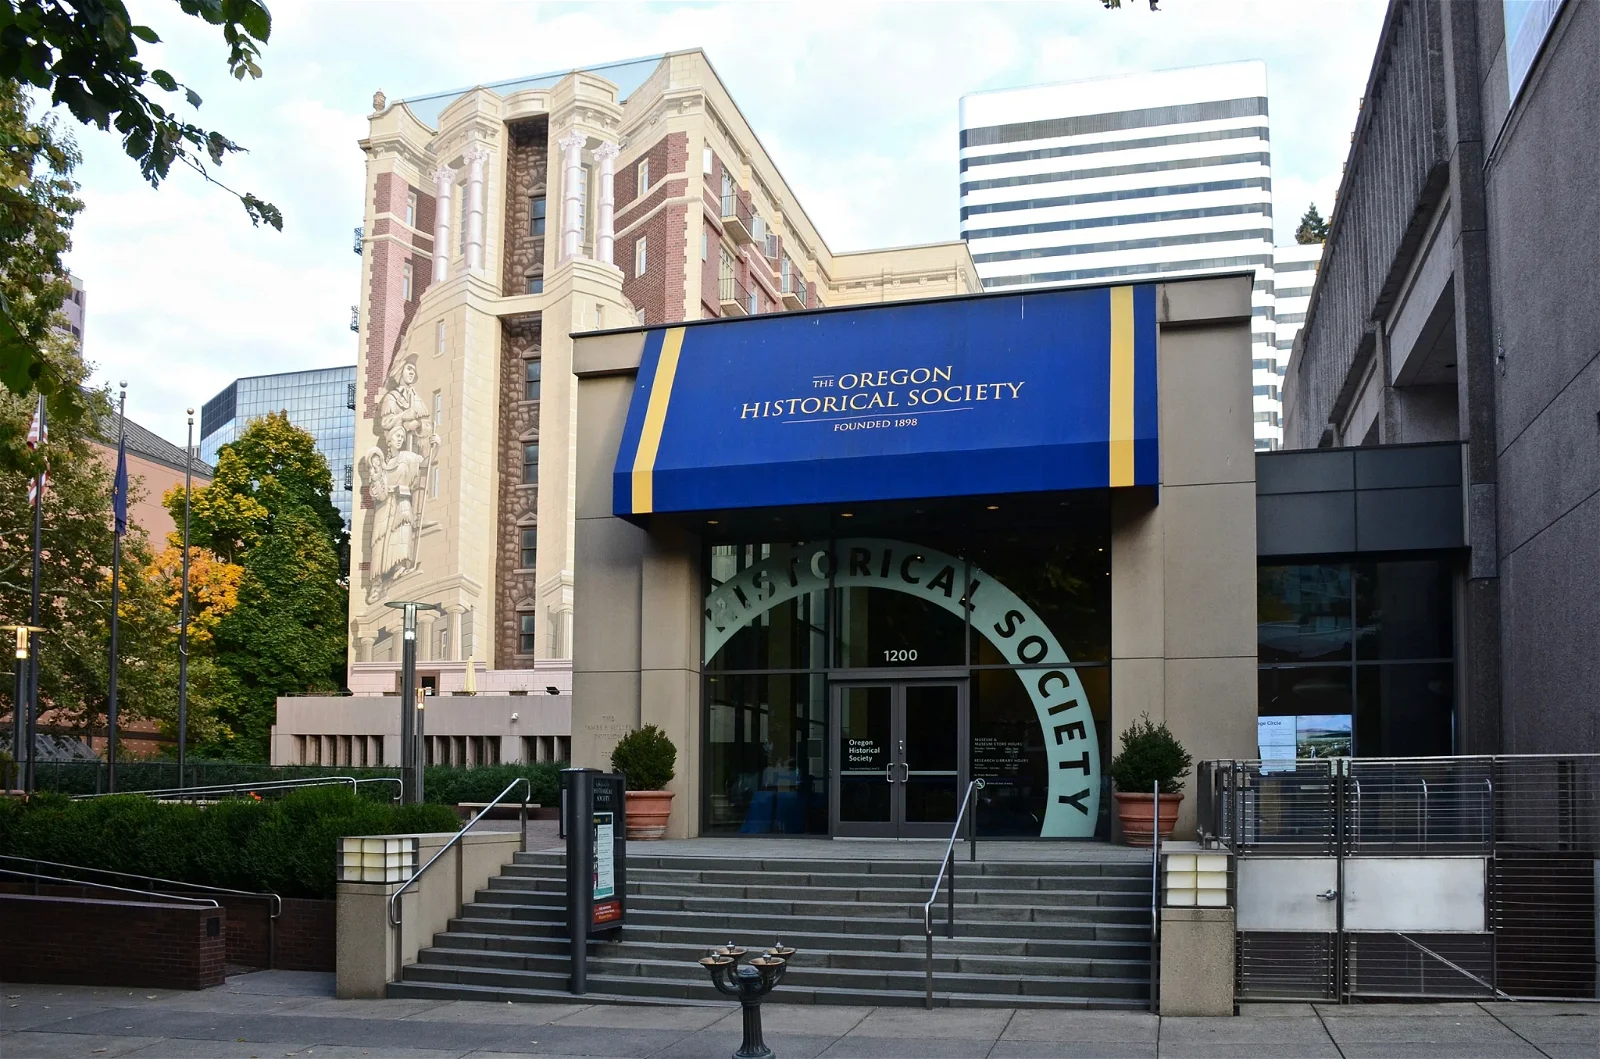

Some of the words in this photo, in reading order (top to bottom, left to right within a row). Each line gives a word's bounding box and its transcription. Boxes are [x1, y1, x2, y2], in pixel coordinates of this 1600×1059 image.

[812, 378, 834, 388] THE
[838, 365, 953, 390] OREGON
[740, 391, 900, 419] HISTORICAL
[907, 381, 1025, 406] SOCIETY
[834, 420, 891, 432] FOUNDED
[894, 418, 918, 428] 1898
[883, 649, 918, 662] 1200
[994, 609, 1091, 816] SOCIETY
[849, 739, 873, 747] Oregon
[849, 755, 873, 763] Society
